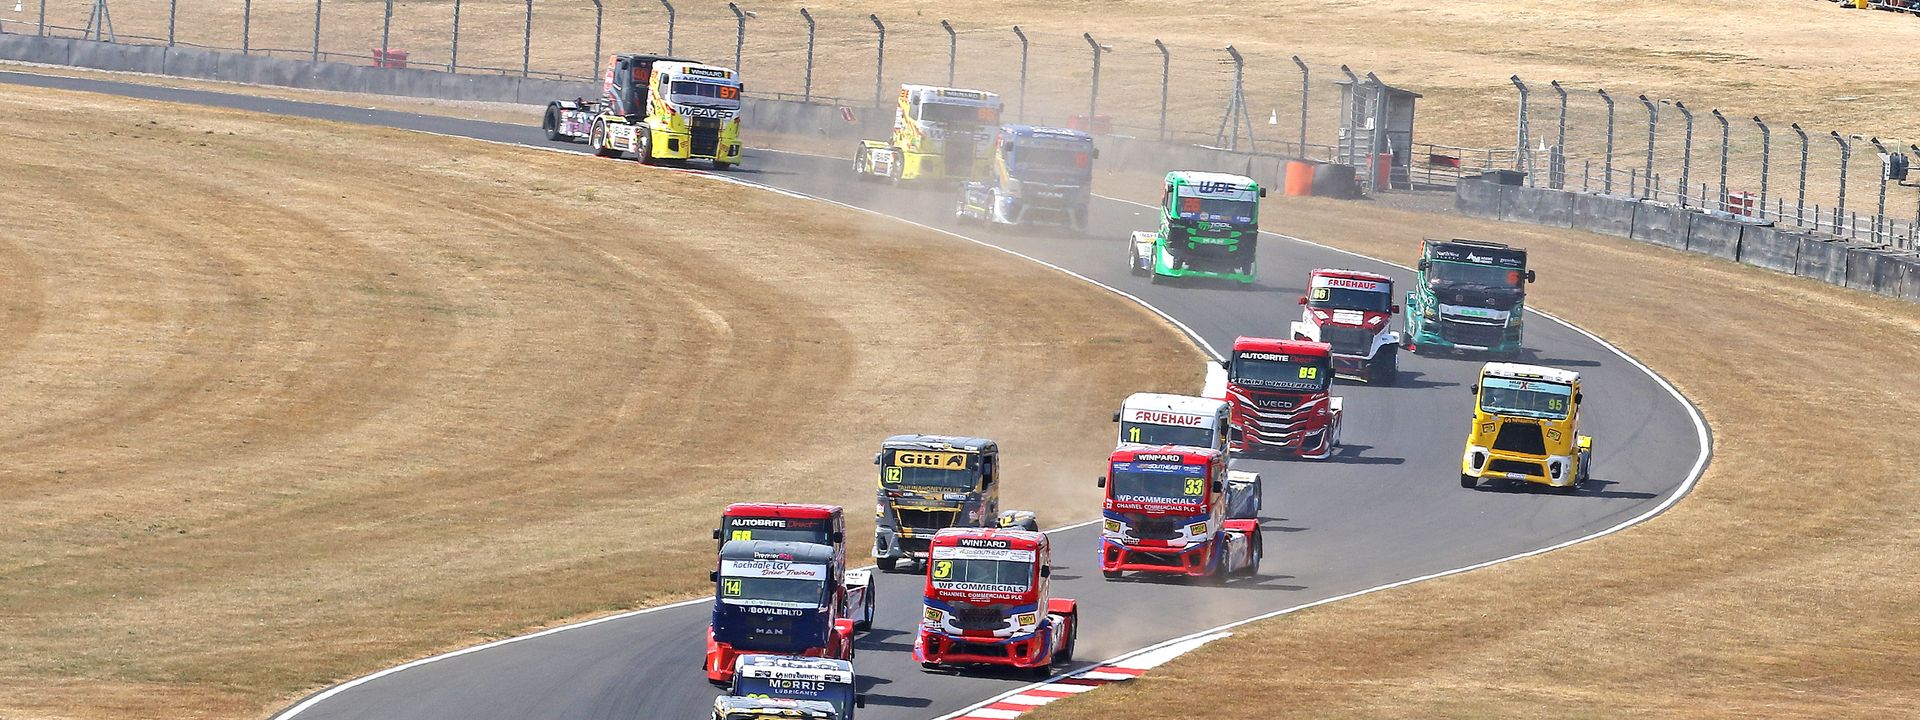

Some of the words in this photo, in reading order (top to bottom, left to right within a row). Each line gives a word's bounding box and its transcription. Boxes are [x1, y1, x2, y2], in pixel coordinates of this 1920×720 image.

[720, 86, 737, 98] 97
[679, 106, 734, 118] WEAVER
[1328, 280, 1376, 289] FRUEHAUF
[1240, 352, 1289, 362] AUTOBRITE
[1259, 399, 1293, 408] IVECO
[1548, 398, 1562, 411] 95
[1136, 411, 1201, 425] FRUEHAUF
[1129, 427, 1141, 442] 11
[899, 453, 940, 466] Giti
[888, 468, 900, 481] 12
[1185, 479, 1203, 494] 33
[1132, 496, 1197, 505] COMMERCIALS
[731, 519, 786, 528] AUTOBRITE
[733, 561, 771, 570] Rochdale
[772, 562, 790, 570] LGV
[934, 561, 952, 578] 3
[726, 581, 740, 595] 14
[955, 583, 1024, 592] COMMERCIALS
[939, 590, 967, 598] CHANNEL
[968, 592, 1010, 600] COMMERCIALS
[769, 679, 825, 691] MORRIS
